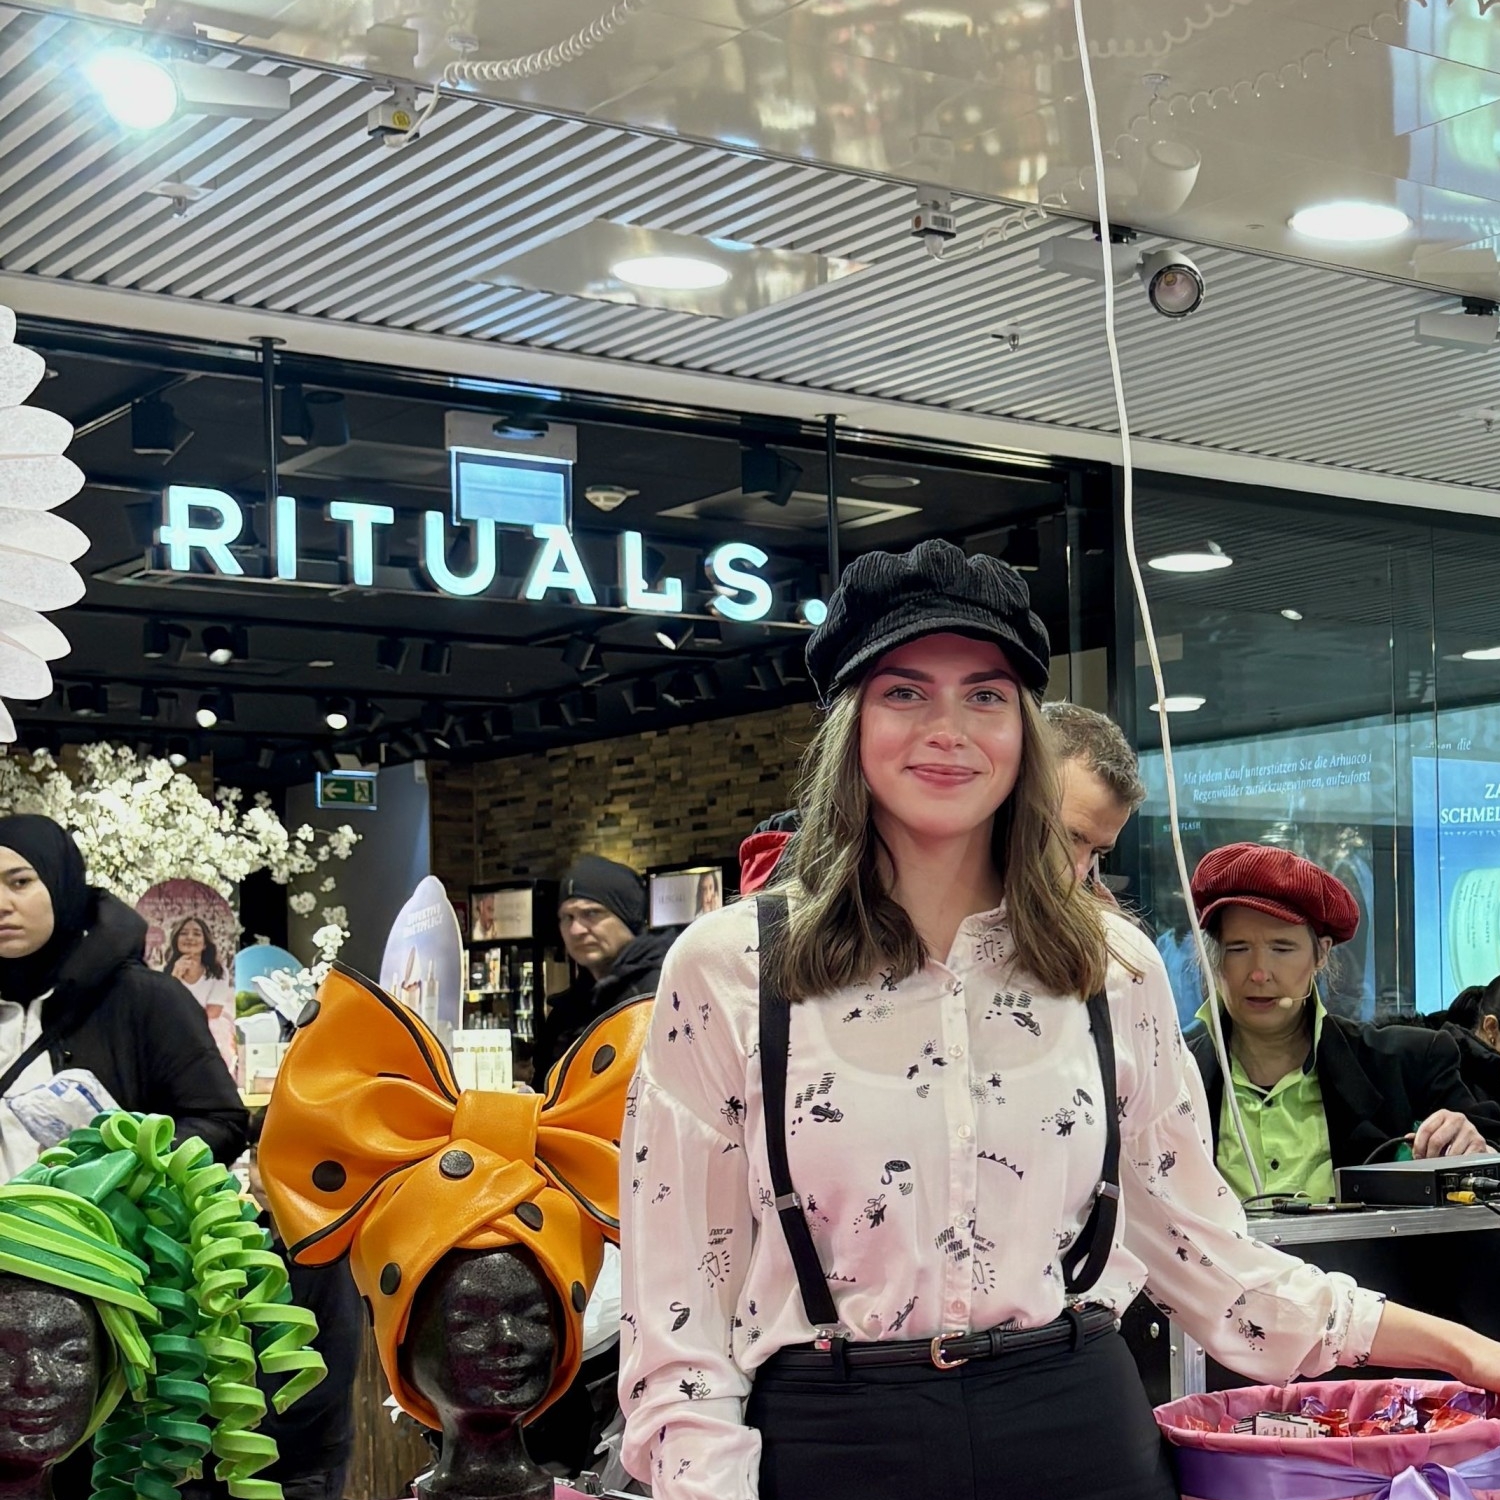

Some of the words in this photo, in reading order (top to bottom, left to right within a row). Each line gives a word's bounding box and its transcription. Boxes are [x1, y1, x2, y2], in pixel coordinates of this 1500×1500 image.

[160, 484, 828, 627] RITUALS.
[1198, 771, 1223, 785] jedem
[1224, 766, 1244, 782] Kauf
[1245, 760, 1298, 778] unterstützen
[1299, 758, 1312, 770] Sie
[1314, 755, 1328, 768] die
[1328, 752, 1367, 768] Arhuaco
[1193, 784, 1244, 803] Regenwälder
